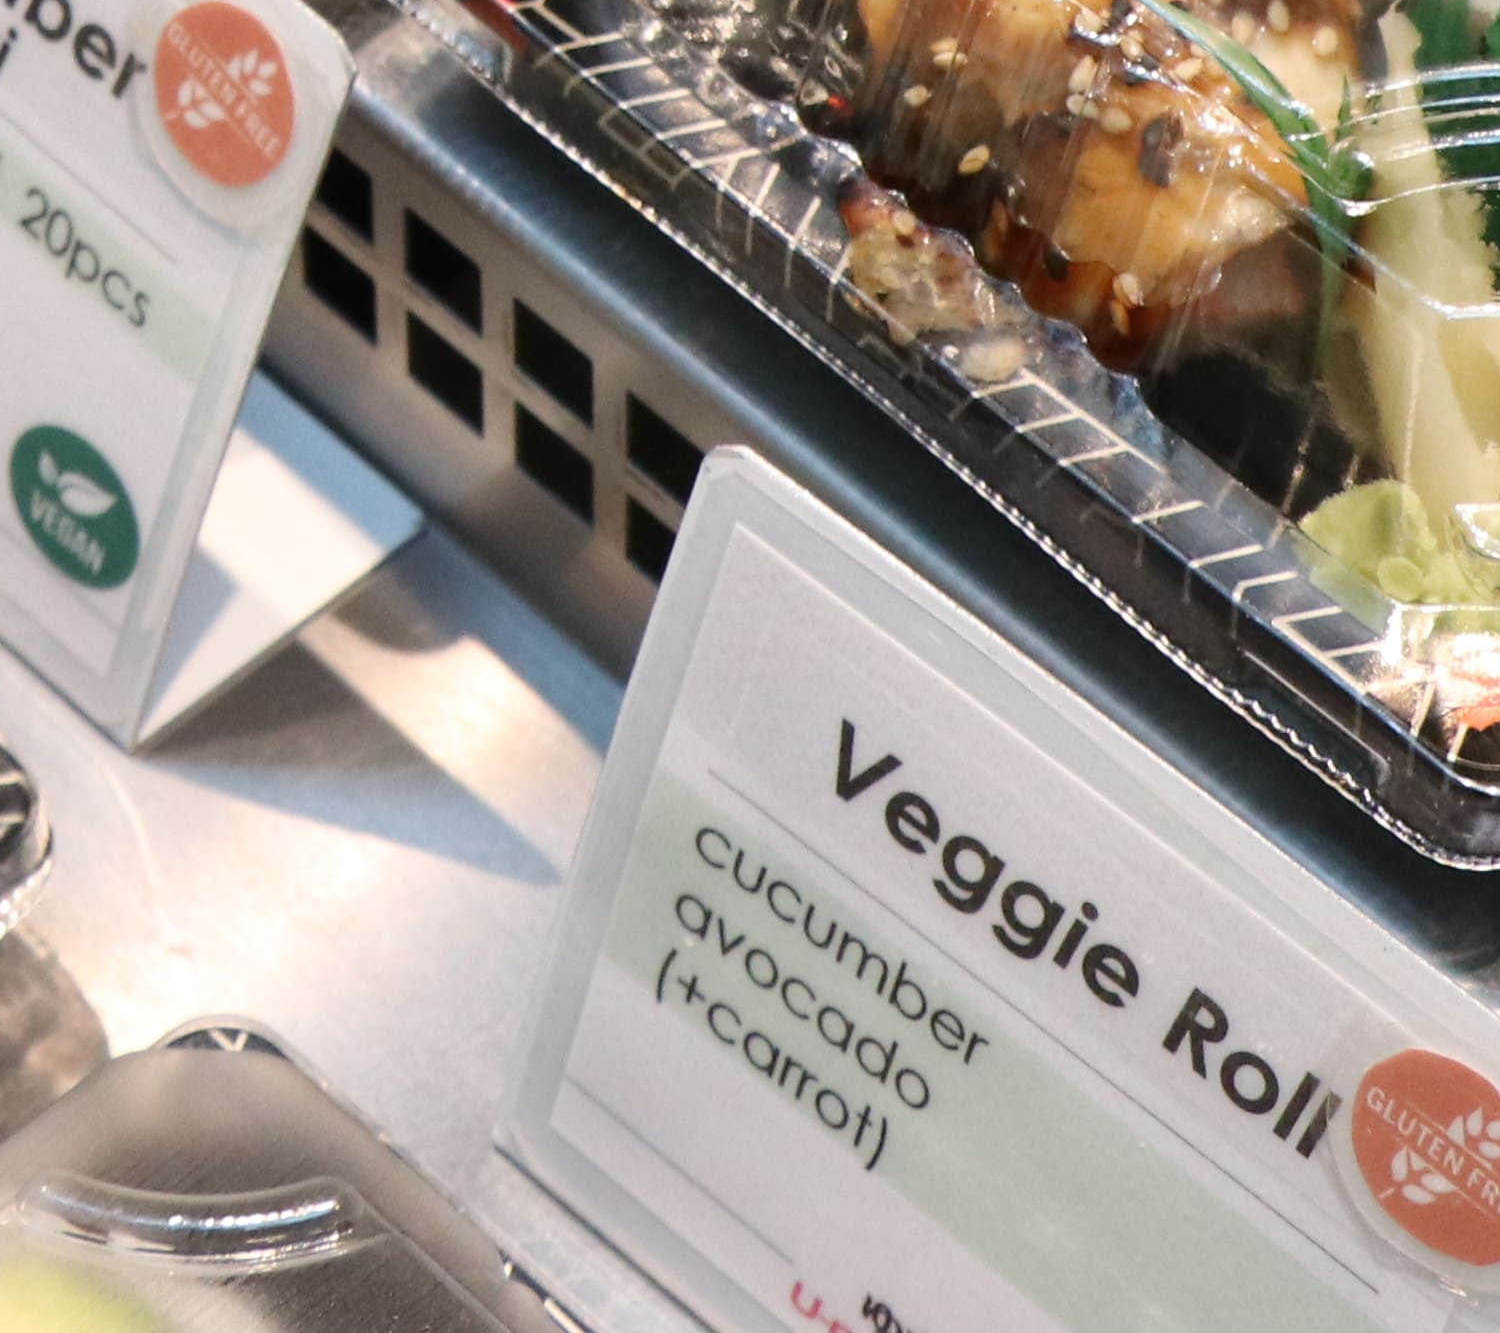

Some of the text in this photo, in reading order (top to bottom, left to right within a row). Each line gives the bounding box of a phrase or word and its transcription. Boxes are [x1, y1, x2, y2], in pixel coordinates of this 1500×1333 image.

[166, 19, 282, 161] GLUTEN FREE
[17, 184, 151, 331] 20pcs
[30, 488, 106, 576] VEGAN
[675, 888, 932, 1111] avocado
[694, 823, 992, 1066] cucumber
[830, 718, 1344, 1161] Veggie Roll
[653, 947, 889, 1173] (+carrot)
[1366, 1085, 1466, 1176] GLUTEN
